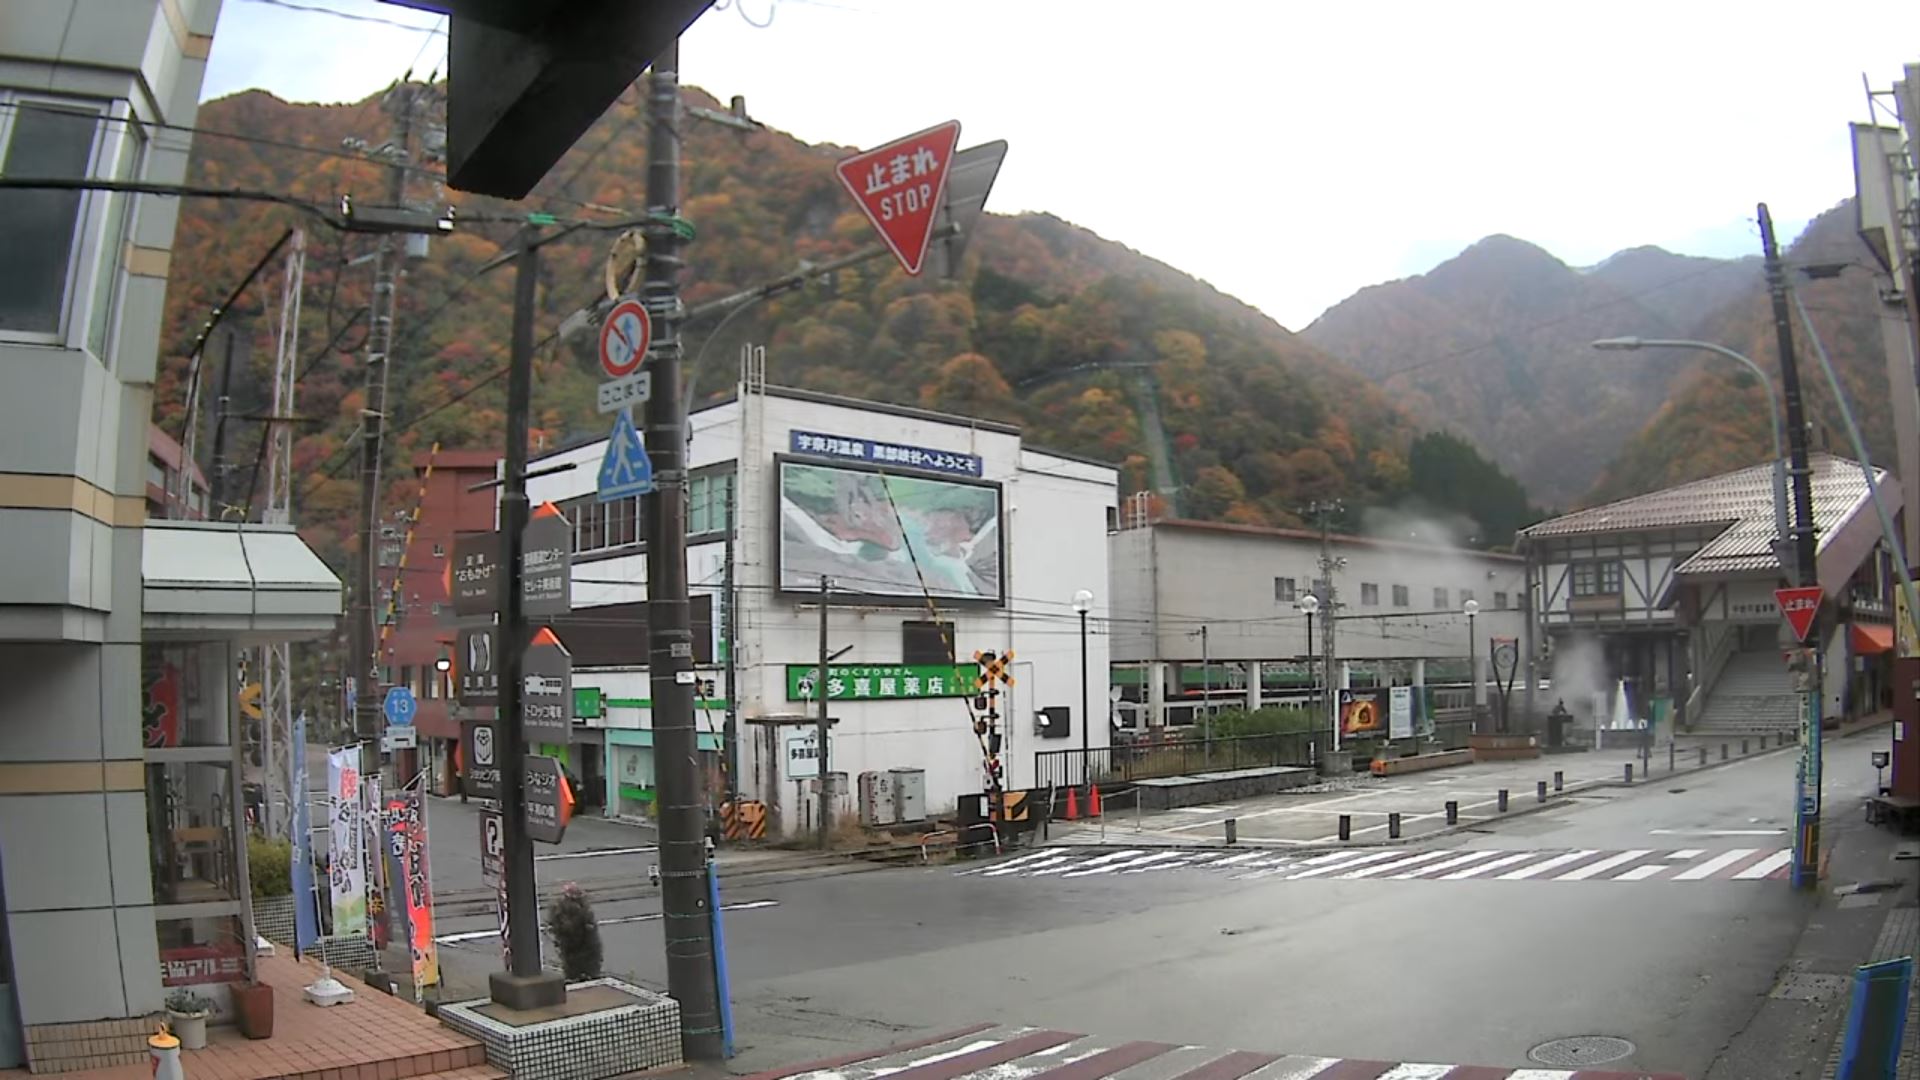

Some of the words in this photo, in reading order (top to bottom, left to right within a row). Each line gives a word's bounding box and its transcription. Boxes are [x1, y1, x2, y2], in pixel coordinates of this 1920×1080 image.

[865, 147, 938, 195] 止まれ
[880, 184, 931, 221] STOP
[601, 379, 646, 405] ここまで
[798, 434, 865, 457] 宇奈月温泉
[872, 444, 977, 472] 黒部峡谷へようこそ
[1784, 598, 1816, 612] 止まれ
[827, 676, 944, 697] 多喜屋薬店
[391, 698, 409, 714] 13
